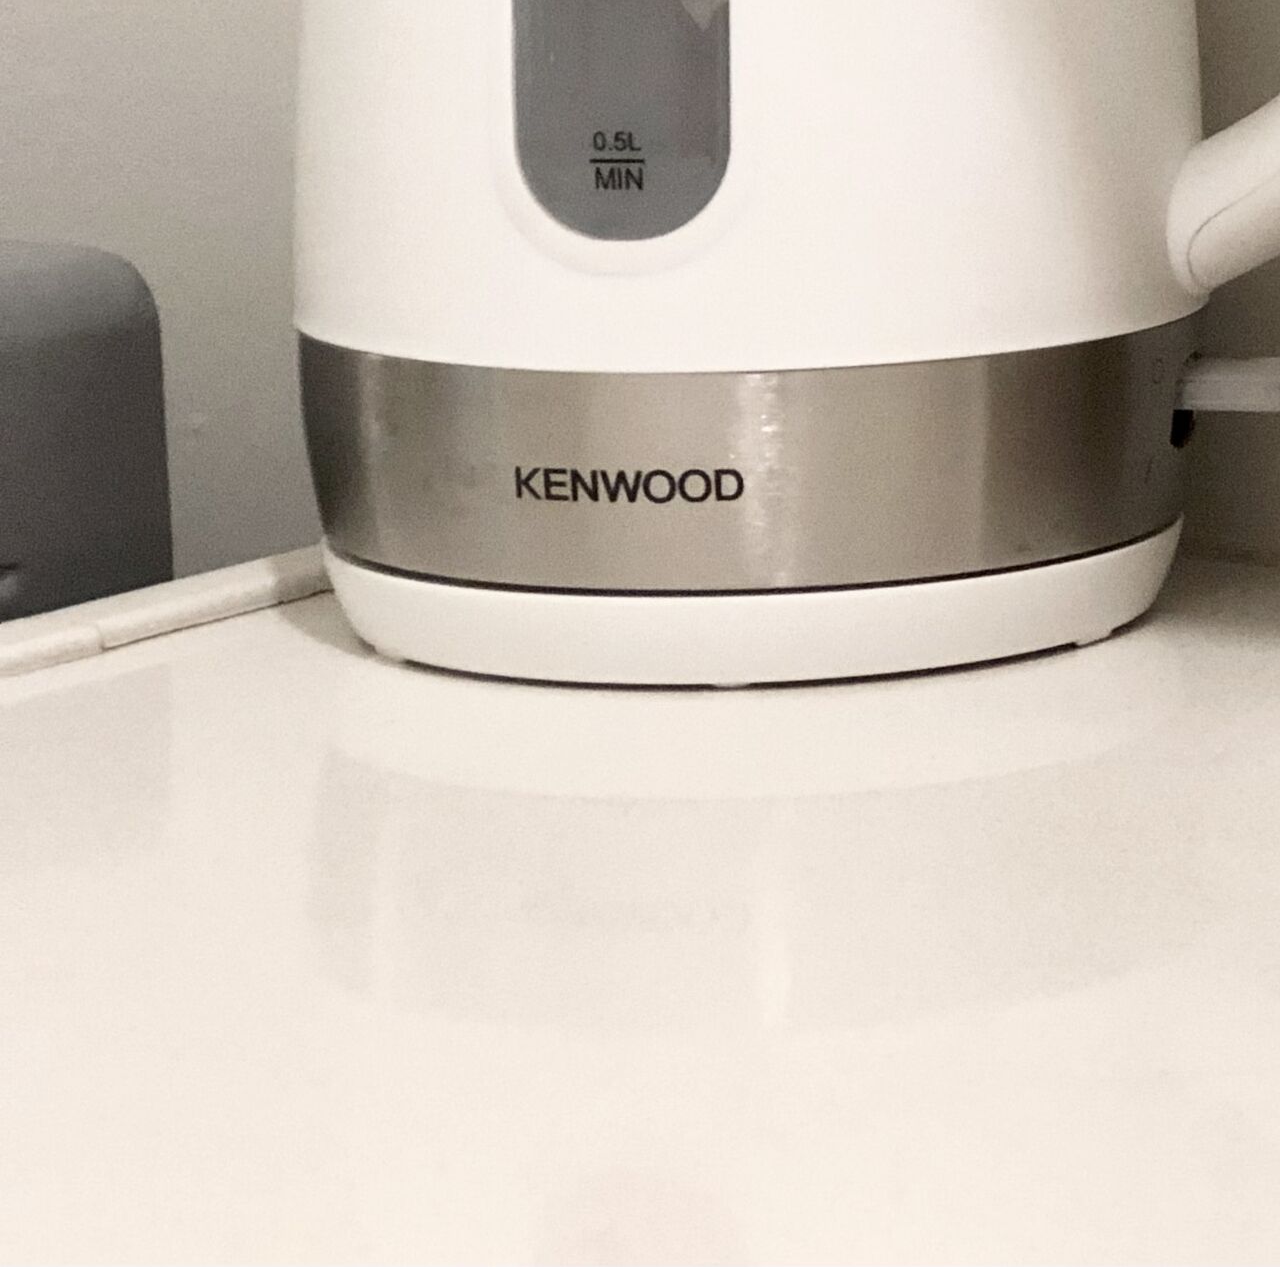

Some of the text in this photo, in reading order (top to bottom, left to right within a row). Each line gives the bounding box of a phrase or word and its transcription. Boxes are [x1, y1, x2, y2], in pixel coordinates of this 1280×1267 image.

[593, 131, 642, 151] 0.5L
[595, 167, 643, 190] MIN
[514, 466, 745, 504] KENWOOD
